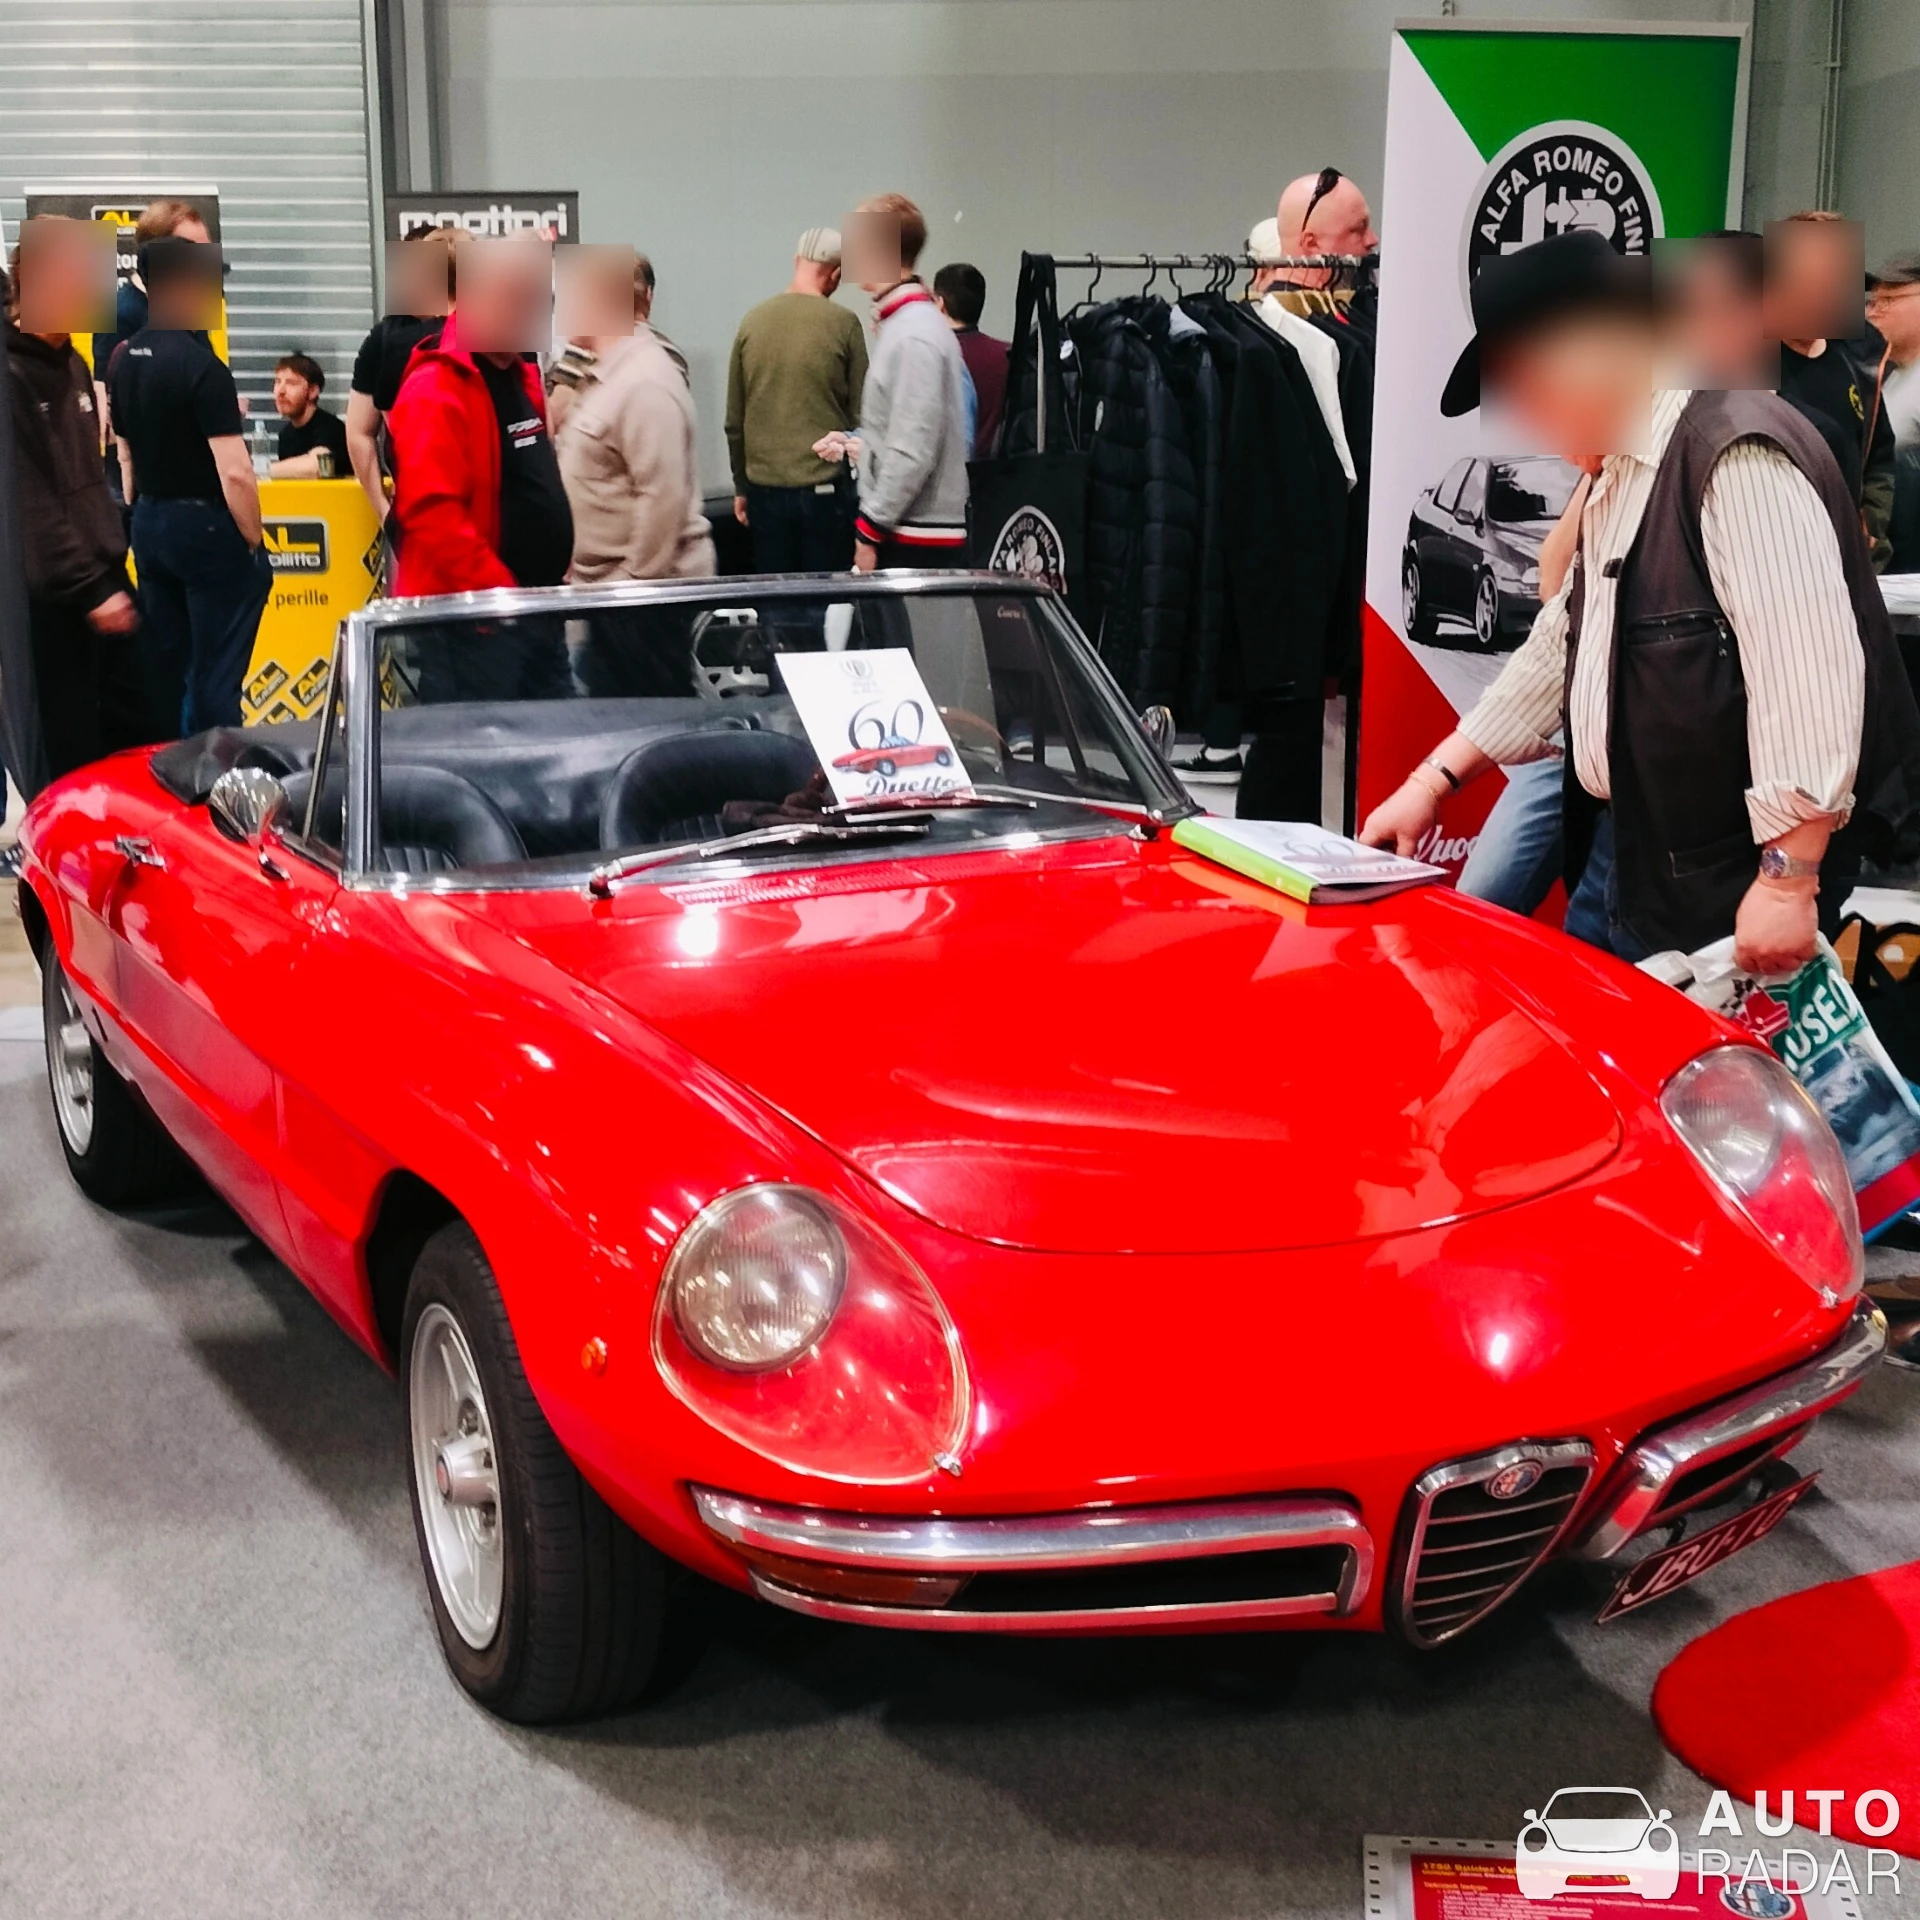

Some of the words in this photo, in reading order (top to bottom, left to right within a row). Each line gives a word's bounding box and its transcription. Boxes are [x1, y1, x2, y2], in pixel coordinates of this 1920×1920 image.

[1481, 168, 1530, 245] ALFA
[1533, 146, 1624, 196] ROMEO
[1618, 195, 1644, 255] FIN
[276, 590, 329, 610] perille
[848, 699, 924, 750] 60
[1784, 968, 1860, 1072] USEO
